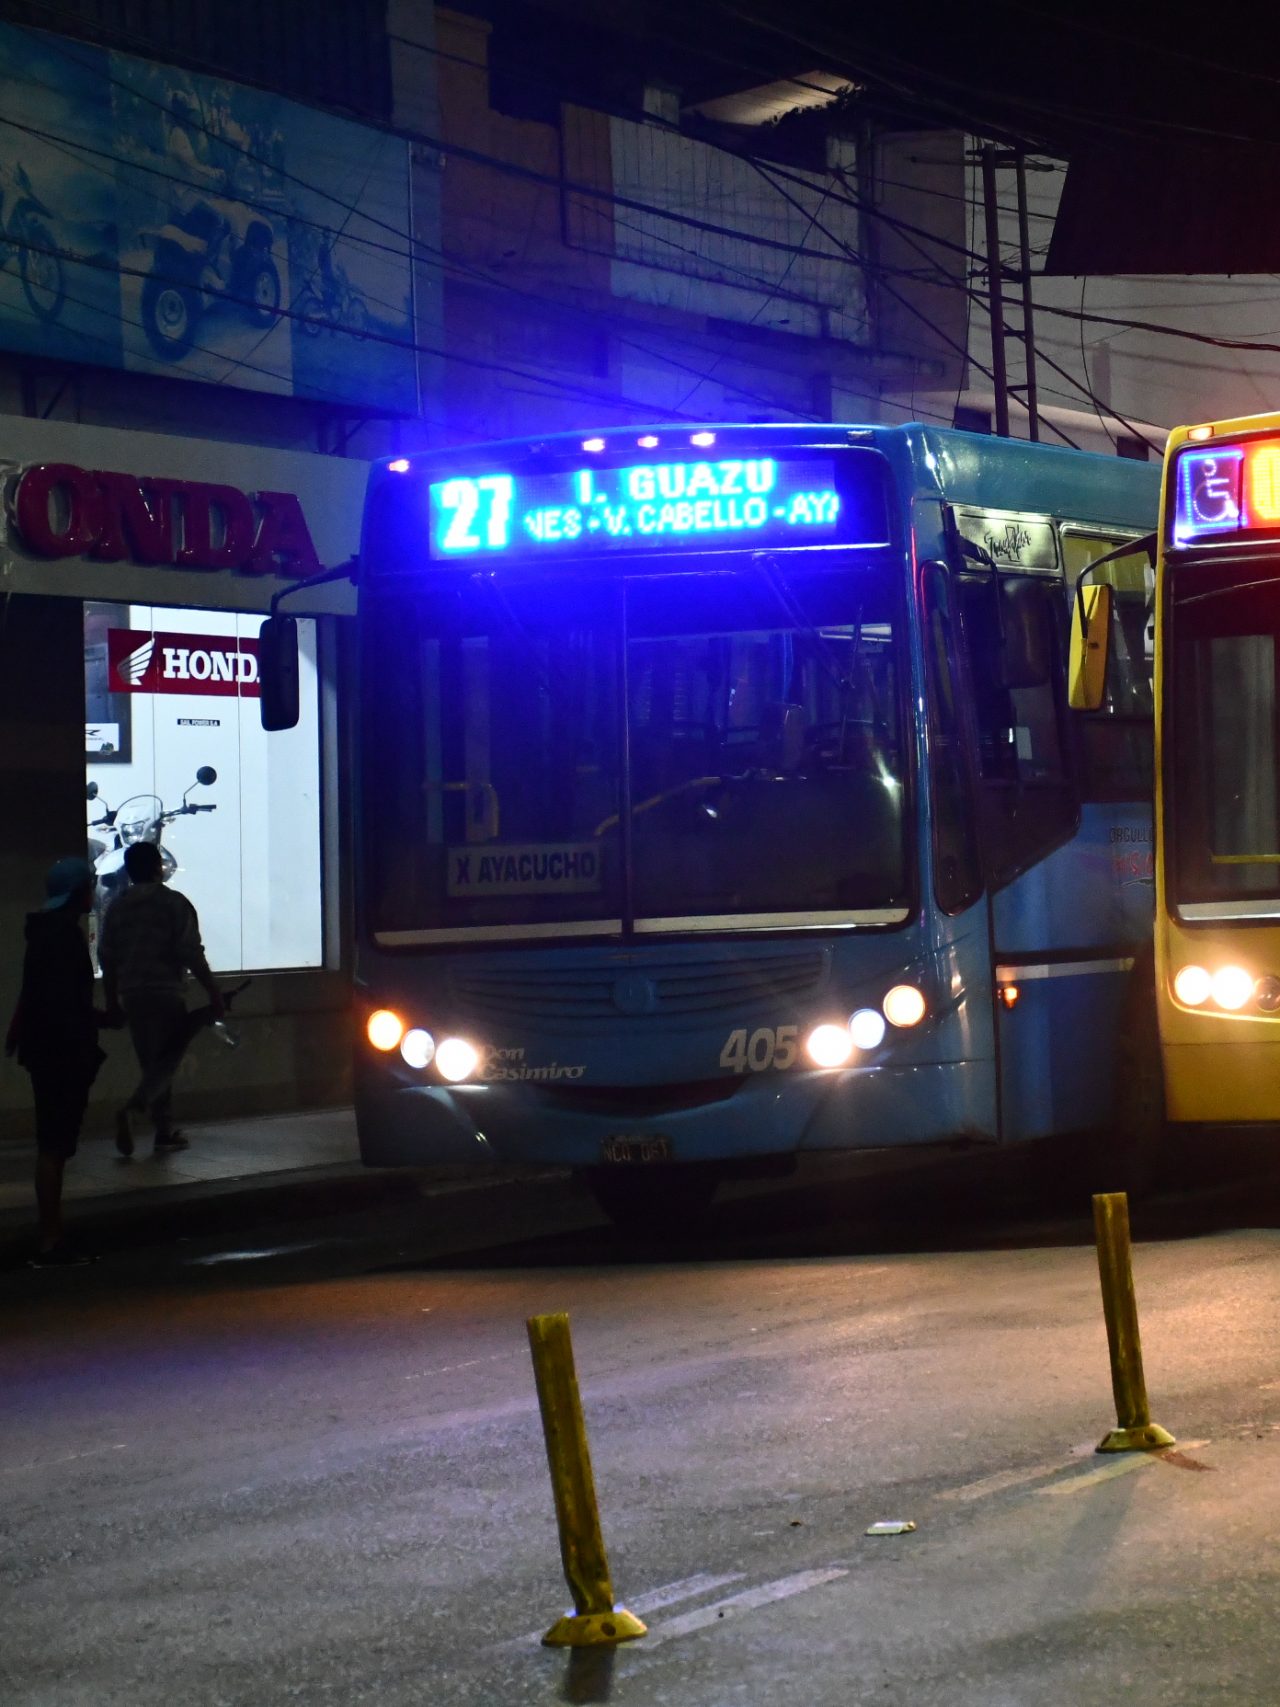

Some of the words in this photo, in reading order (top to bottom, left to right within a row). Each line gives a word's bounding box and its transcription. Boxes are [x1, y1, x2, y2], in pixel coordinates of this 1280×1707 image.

[627, 458, 775, 501] GUAZU
[14, 463, 327, 575] ONDA
[441, 472, 514, 549] 27
[637, 496, 769, 534] CABELLO
[162, 648, 261, 684] HOND
[456, 856, 472, 885] X
[478, 851, 597, 884] AYACUCHO
[719, 1025, 799, 1074] 405
